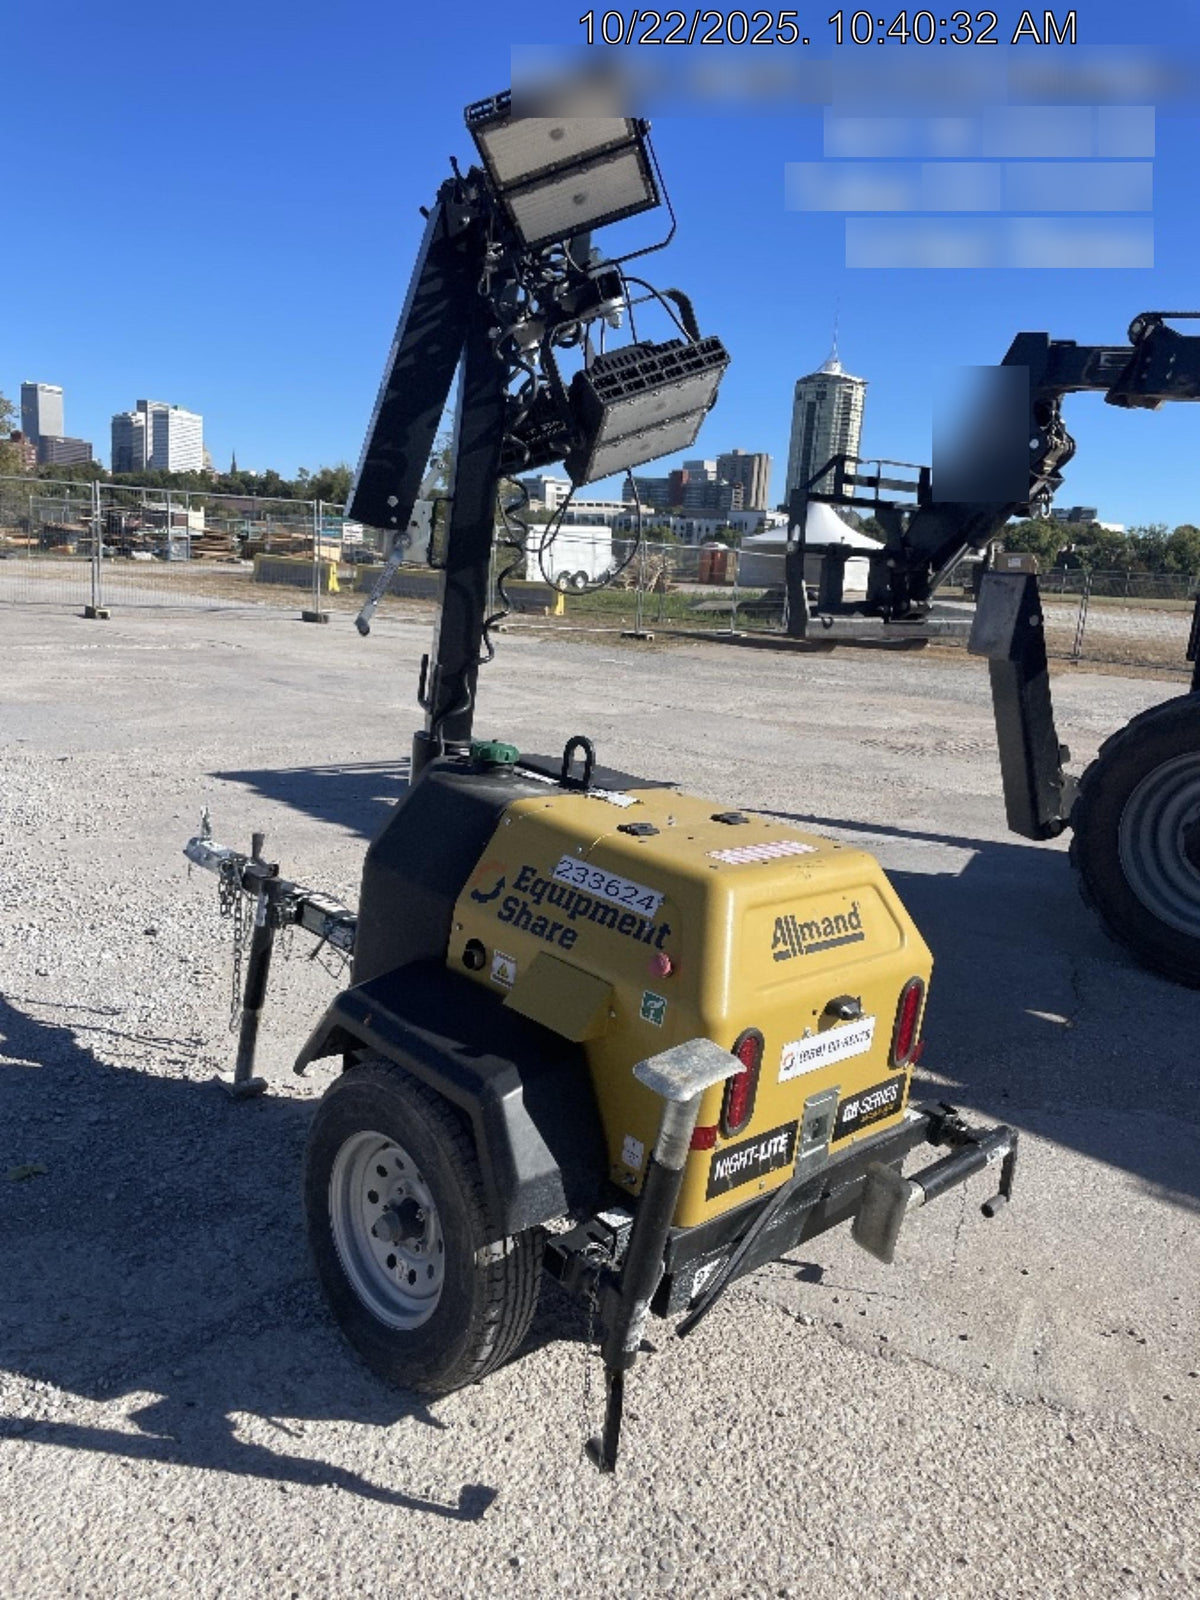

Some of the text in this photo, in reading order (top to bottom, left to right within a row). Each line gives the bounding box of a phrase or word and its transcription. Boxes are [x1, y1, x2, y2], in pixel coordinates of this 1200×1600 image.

[512, 865, 671, 950] Equipment
[555, 860, 655, 912] 233624
[497, 895, 579, 951] Share
[771, 901, 863, 957] Allmand
[714, 1131, 790, 1182] NIGHT-LITE
